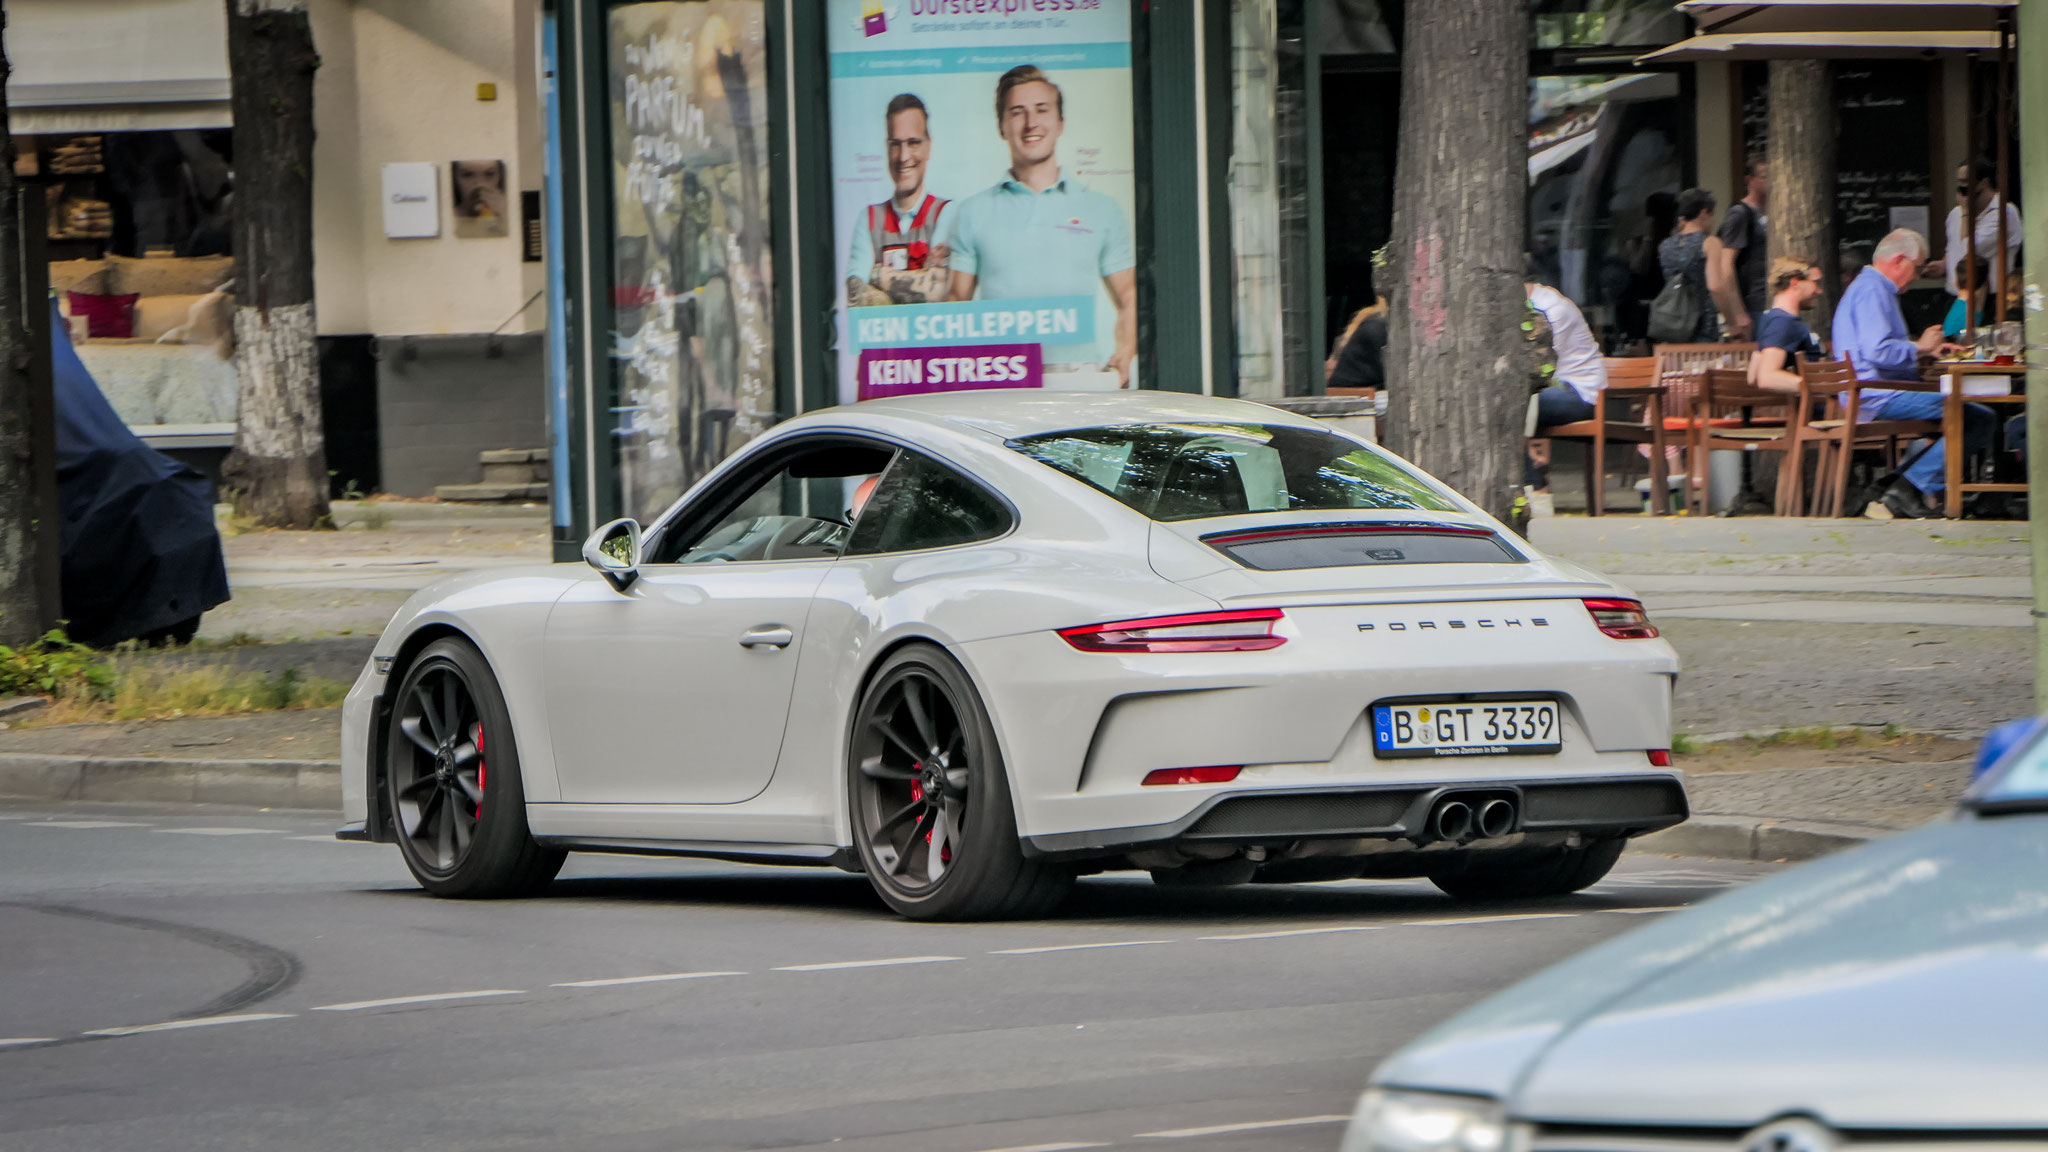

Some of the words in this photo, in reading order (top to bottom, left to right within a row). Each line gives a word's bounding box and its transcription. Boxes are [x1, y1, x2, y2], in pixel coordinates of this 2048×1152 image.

[911, 0, 1100, 17] Durstexpress.de
[858, 316, 909, 343] KEIN
[914, 308, 1078, 341] SCHLEPPEN
[868, 359, 923, 385] KEIN
[927, 355, 1028, 384] STRESS
[1357, 618, 1549, 632] PORSCHE
[1380, 731, 1389, 742] D
[1394, 710, 1414, 744] B
[1436, 708, 1473, 742] GT
[1483, 707, 1554, 741] 3339
